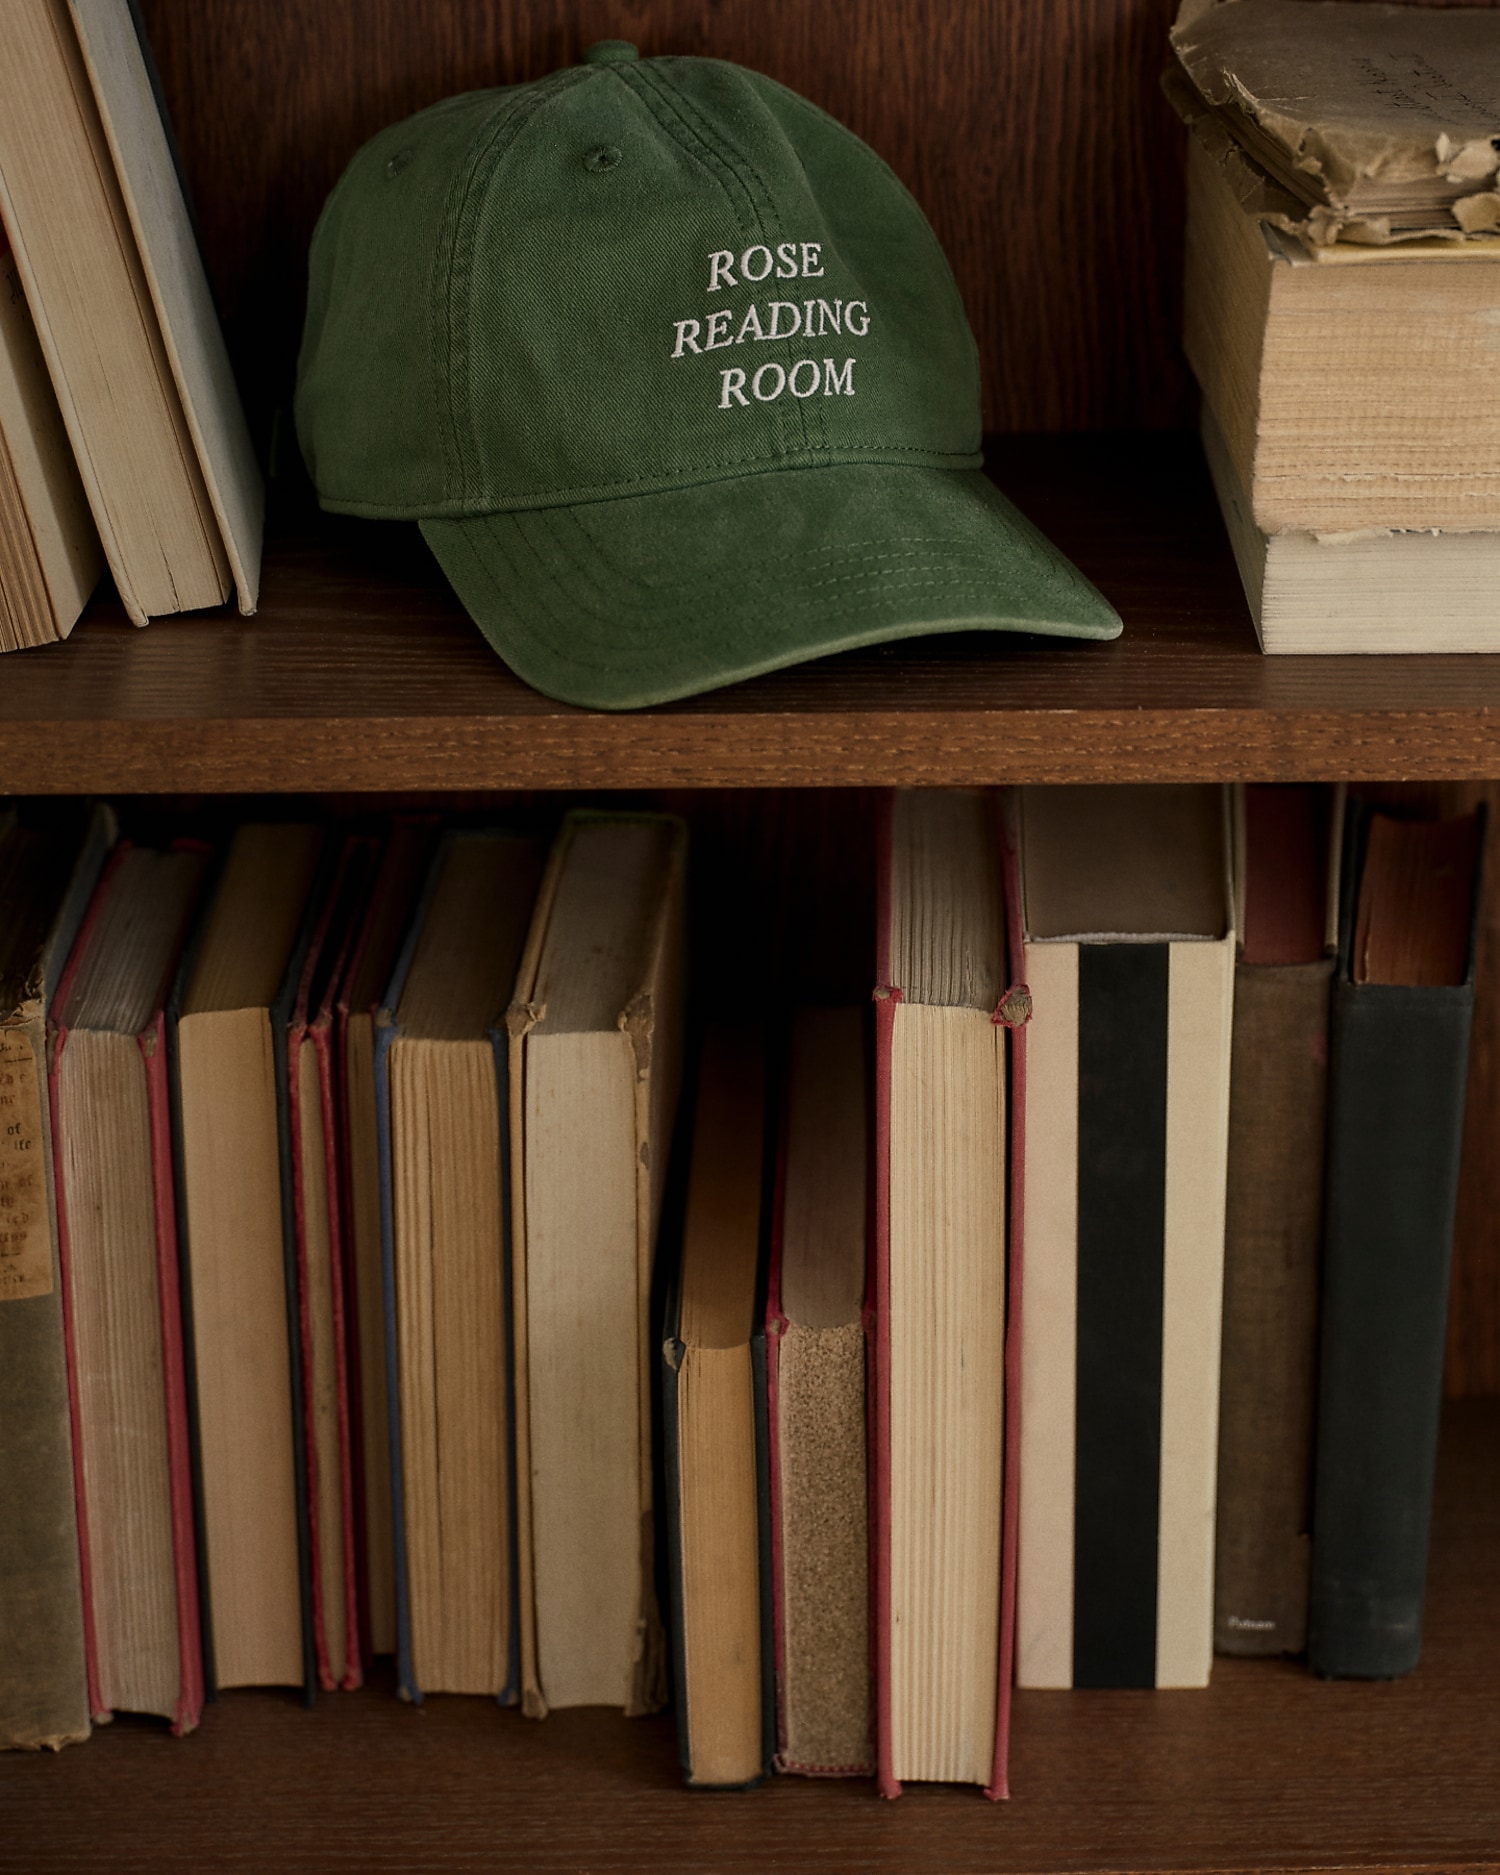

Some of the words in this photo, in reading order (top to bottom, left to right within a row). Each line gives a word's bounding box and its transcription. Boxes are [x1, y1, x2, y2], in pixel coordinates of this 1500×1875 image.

[707, 242, 825, 292] ROSE
[670, 298, 871, 358] READING
[718, 357, 857, 409] ROOM
